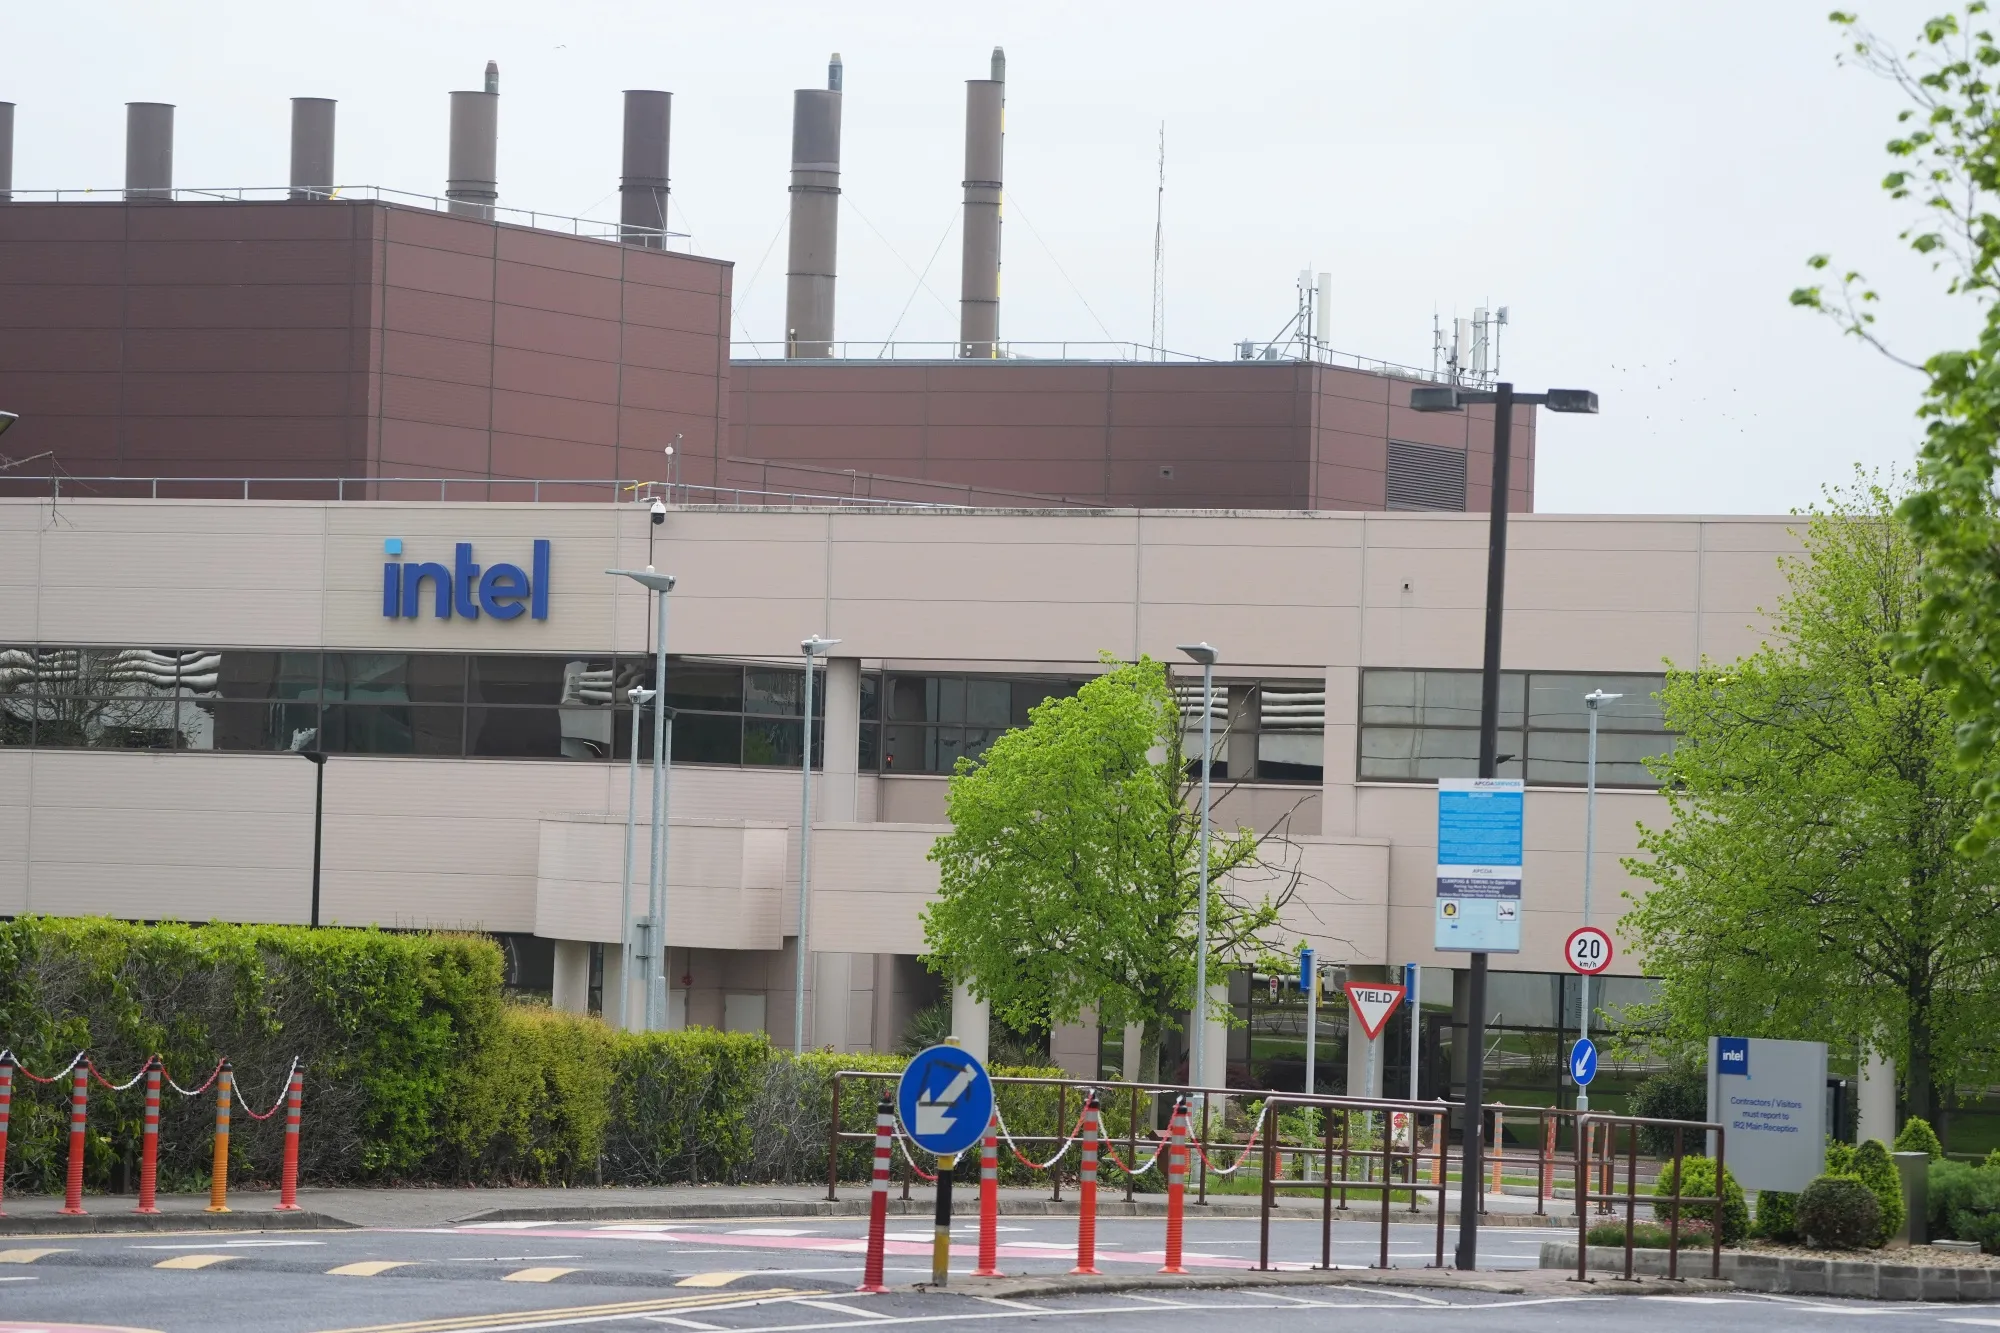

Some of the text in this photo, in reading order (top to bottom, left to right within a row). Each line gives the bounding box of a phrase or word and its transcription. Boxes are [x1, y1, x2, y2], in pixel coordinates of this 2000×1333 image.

[383, 538, 550, 619] intel
[1577, 938, 1600, 959] 20
[1579, 960, 1597, 968] km/h
[1355, 990, 1393, 1003] YIELD
[1722, 1049, 1744, 1062] intel
[1730, 1096, 1802, 1109] Contractors / Visitors
[1760, 1112, 1781, 1121] report
[1733, 1121, 1799, 1134] IR2 Main Reception
